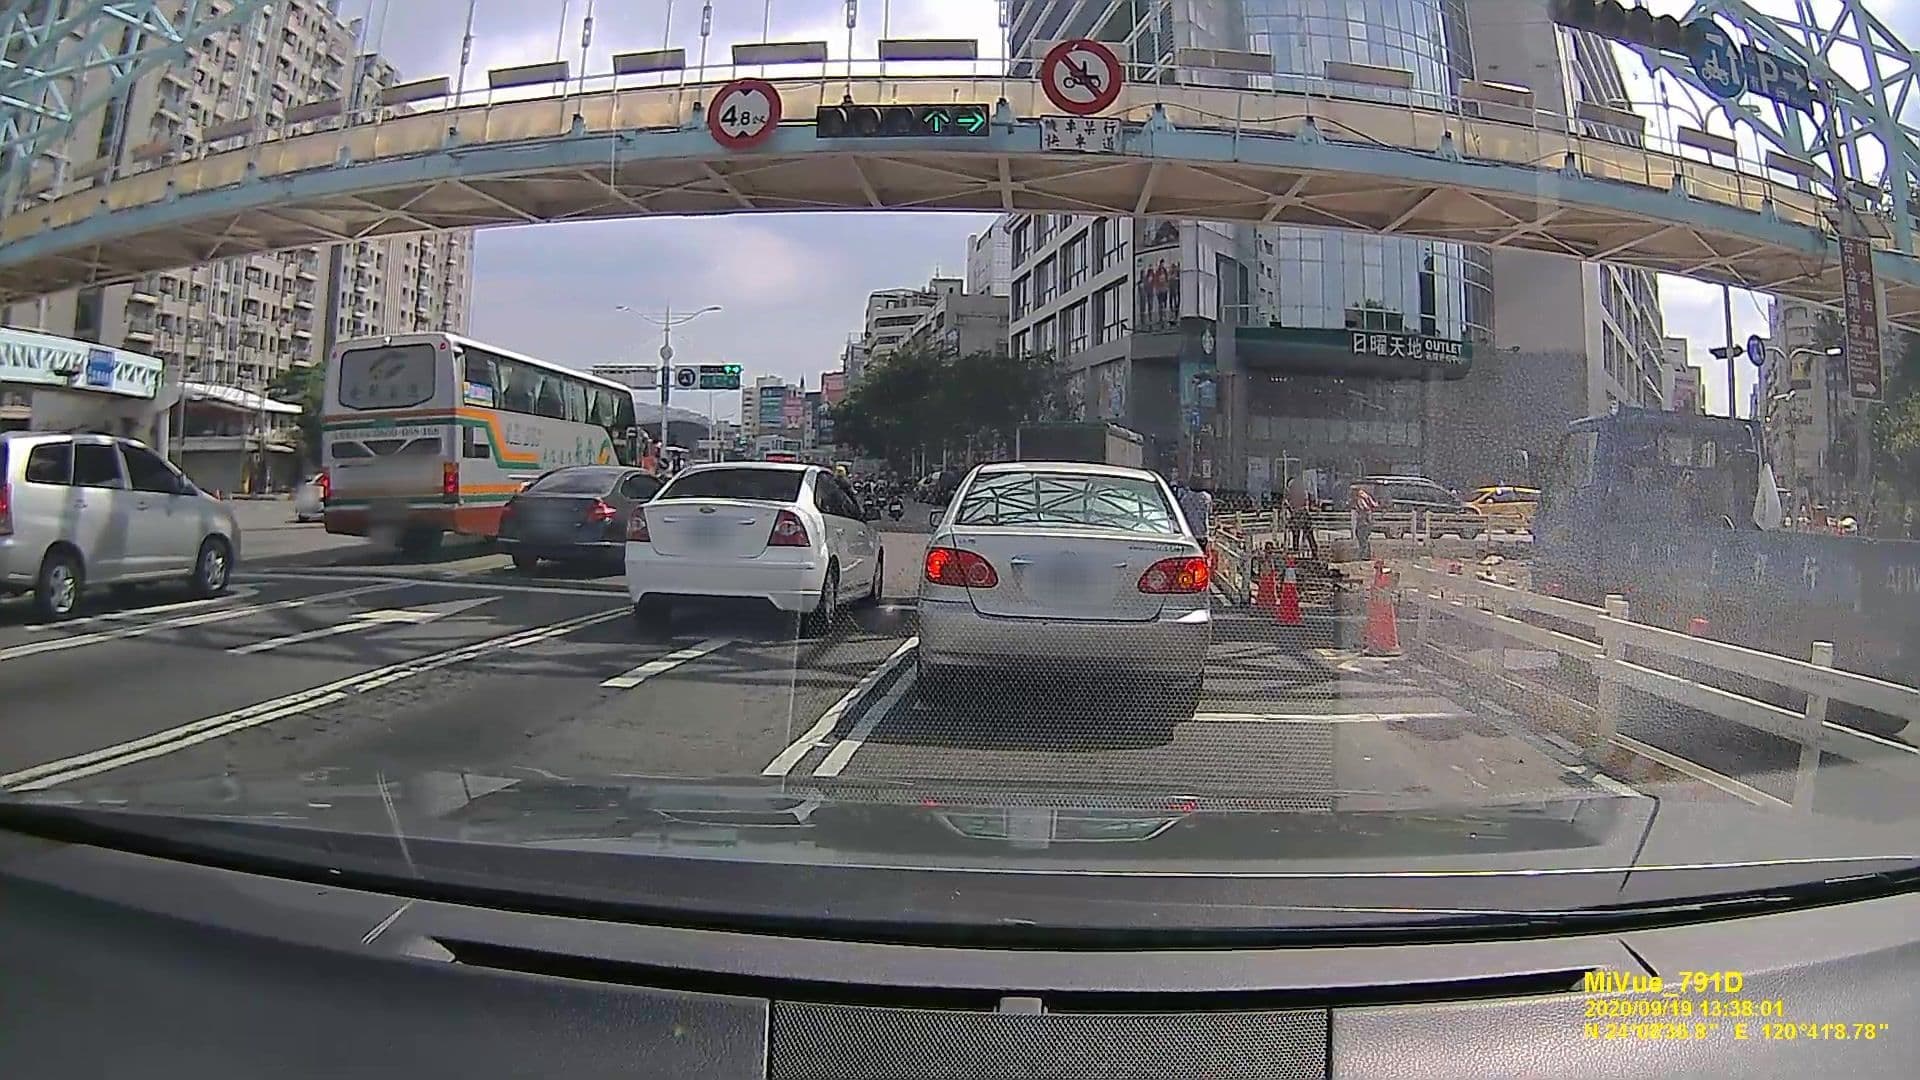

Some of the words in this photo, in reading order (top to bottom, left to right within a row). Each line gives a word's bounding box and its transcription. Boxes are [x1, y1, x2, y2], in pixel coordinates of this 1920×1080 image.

[1354, 333, 1423, 359] 日曜天地
[1425, 339, 1463, 355] OUTLET
